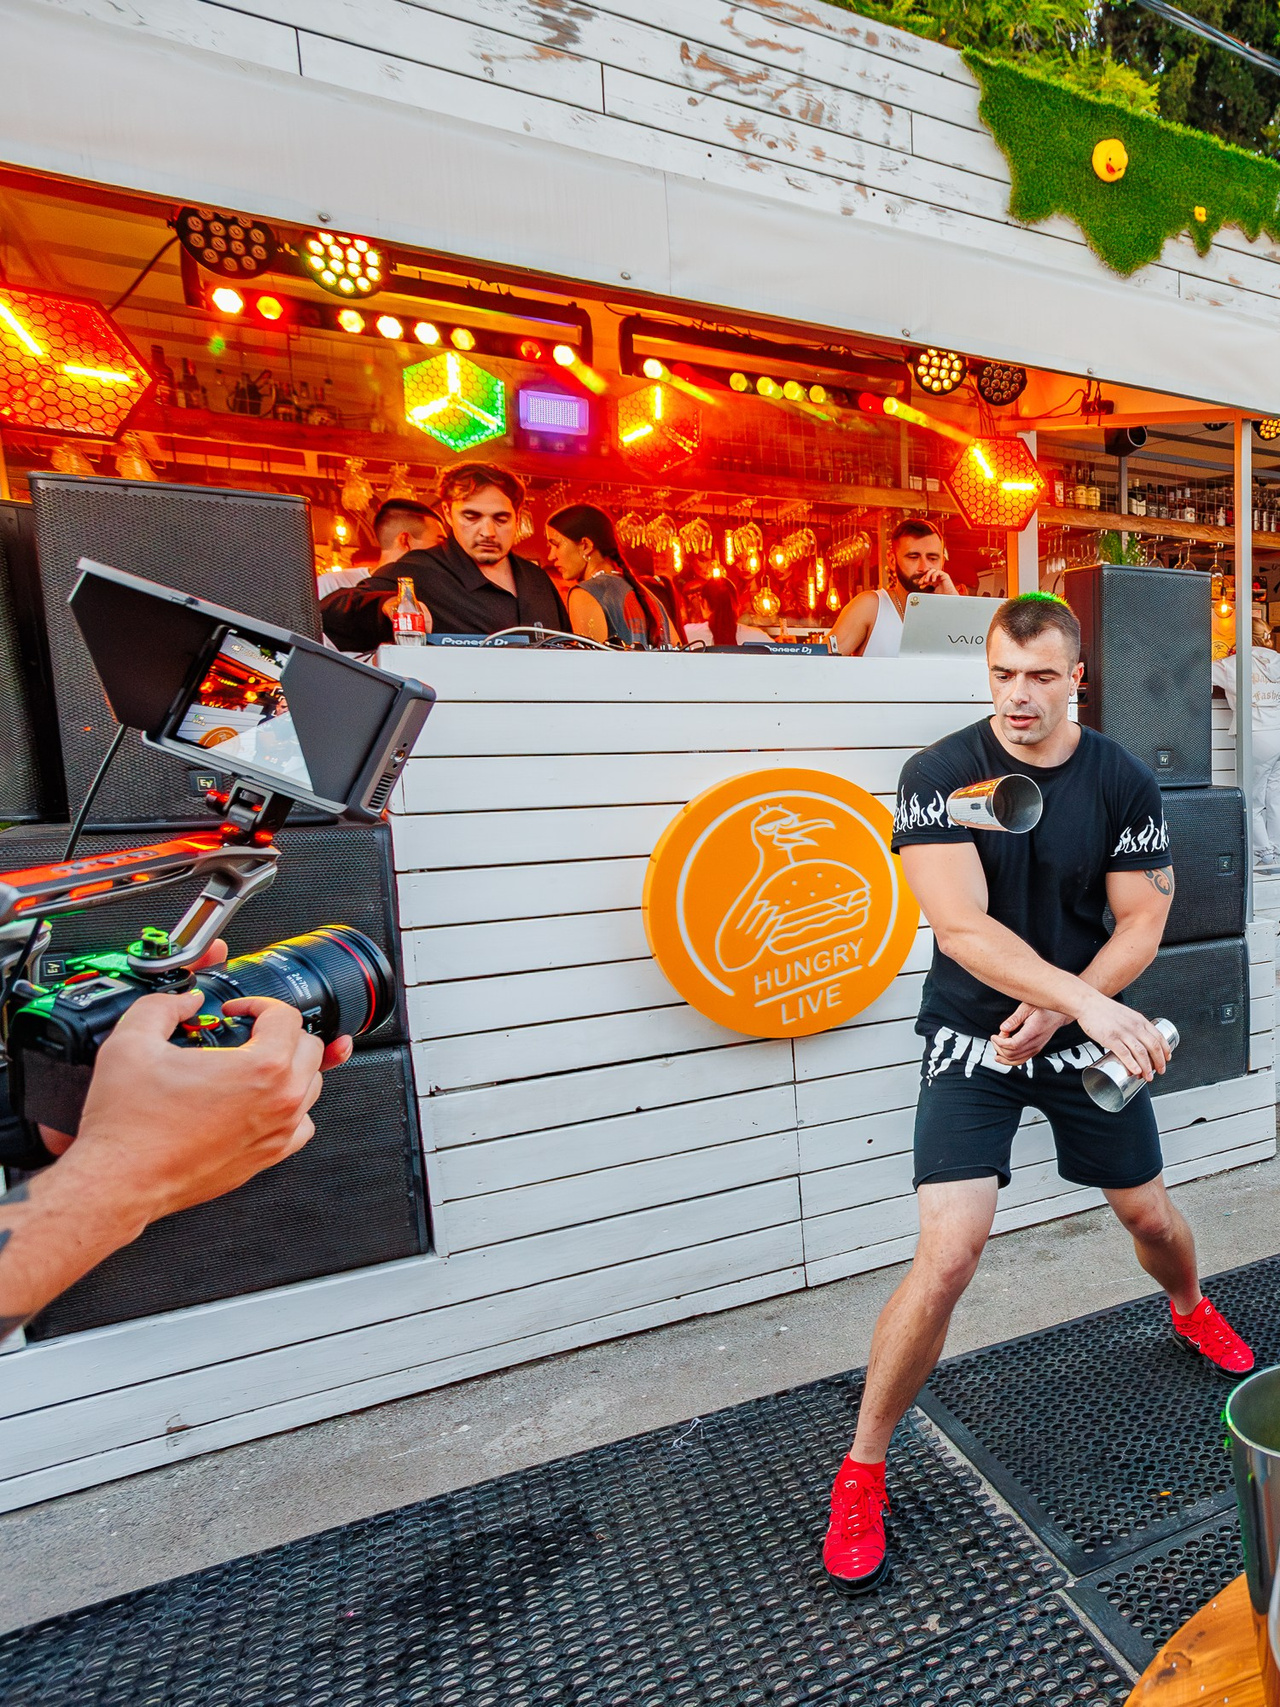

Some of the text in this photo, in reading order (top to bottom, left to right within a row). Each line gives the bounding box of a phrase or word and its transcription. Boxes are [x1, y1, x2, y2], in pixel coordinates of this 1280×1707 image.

[947, 634, 985, 645] VAIO
[753, 937, 864, 996] HUNGRY
[780, 983, 843, 1026] LIVE
